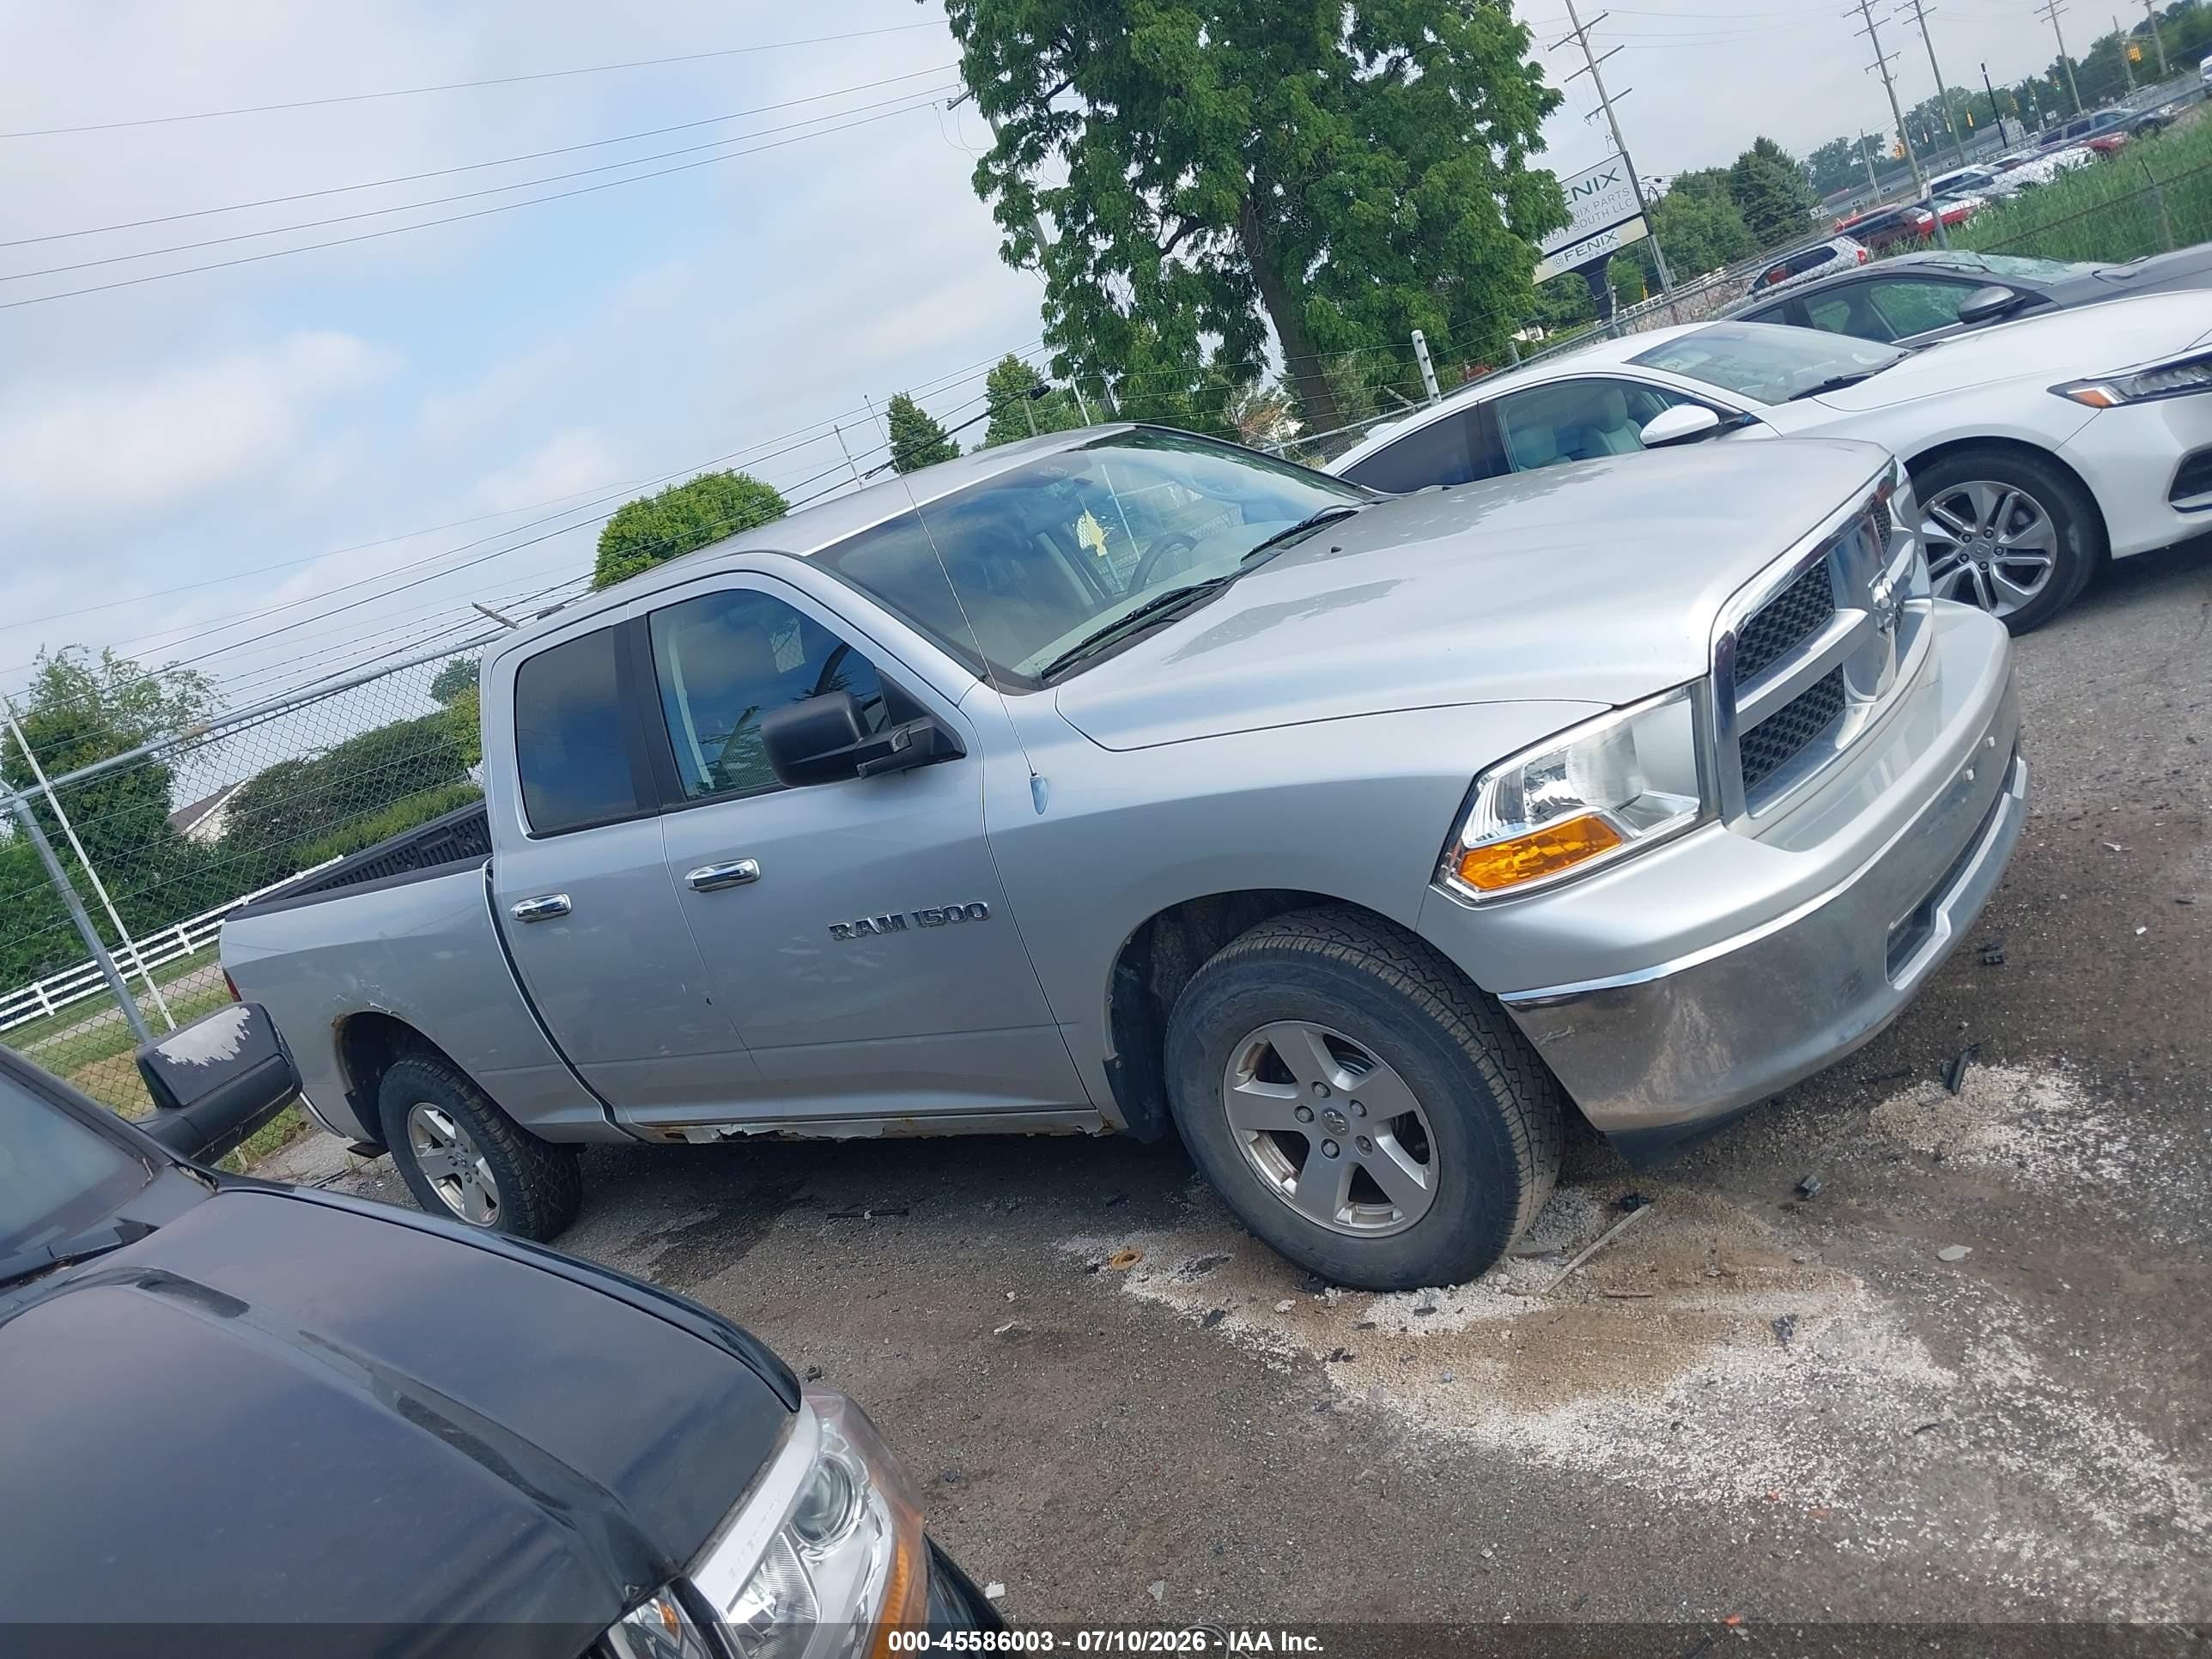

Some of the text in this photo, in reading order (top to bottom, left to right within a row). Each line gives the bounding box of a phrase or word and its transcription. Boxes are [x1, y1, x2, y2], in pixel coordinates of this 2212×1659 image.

[1593, 187, 1630, 210] PARTS
[1573, 210, 1610, 231] SOUTH
[1613, 198, 1633, 213] LLC
[1565, 231, 1618, 261] FENIX
[1588, 242, 1621, 258] PARTS
[828, 900, 991, 941] RAM 1500
